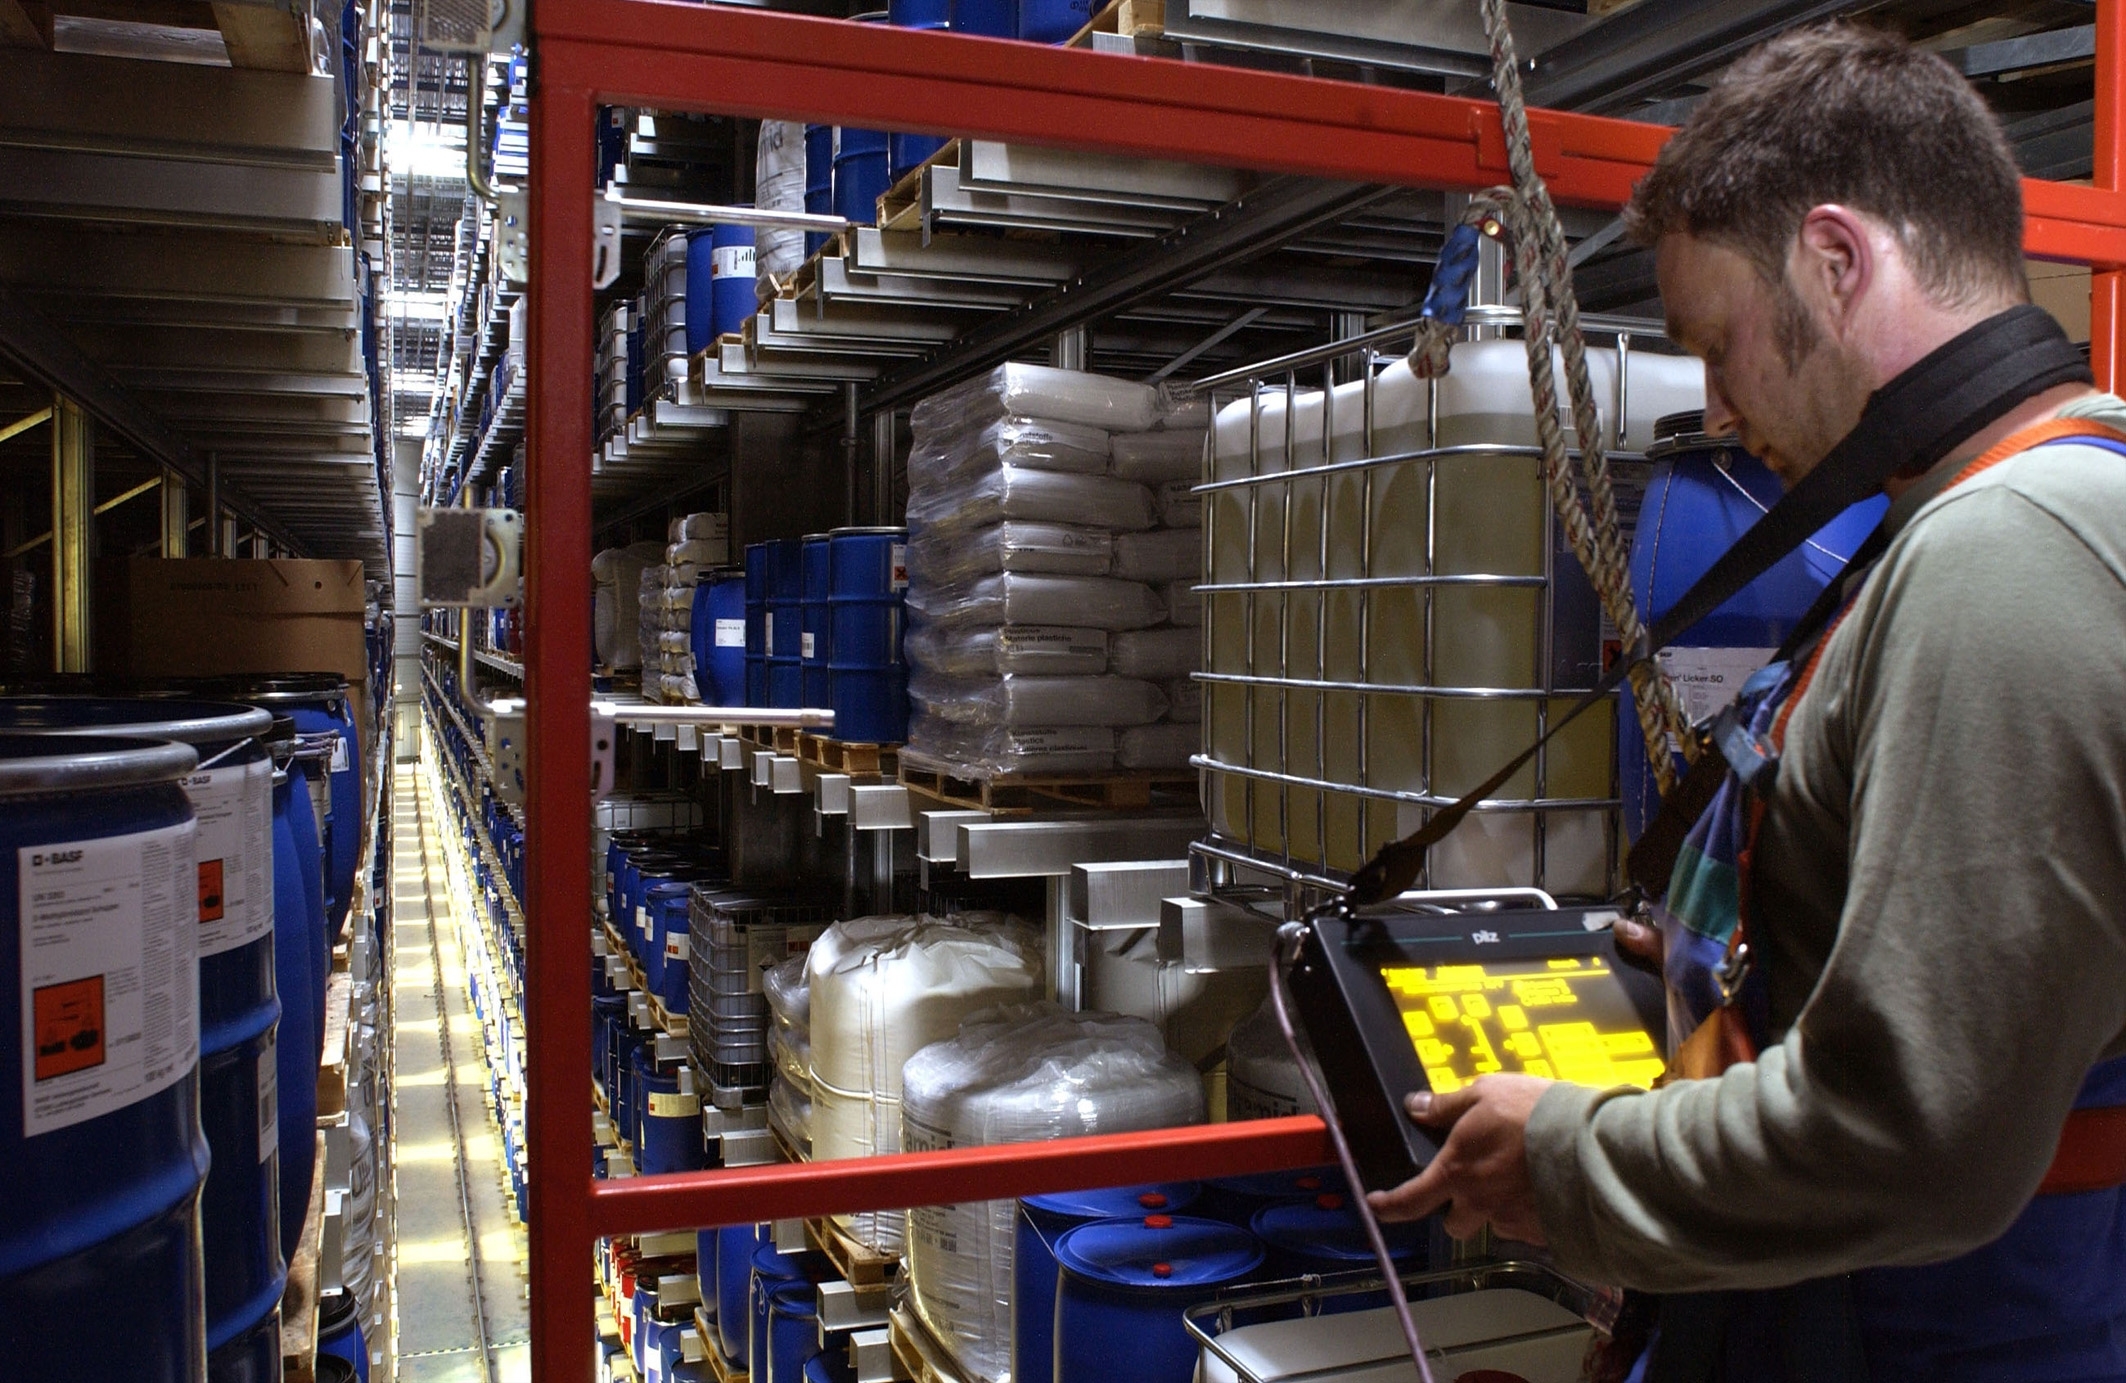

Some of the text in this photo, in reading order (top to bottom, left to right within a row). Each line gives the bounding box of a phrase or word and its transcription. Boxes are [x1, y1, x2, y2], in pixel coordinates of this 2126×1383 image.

[192, 775, 211, 785] BASF
[51, 850, 83, 865] BASF
[1472, 929, 1501, 945] pilz
